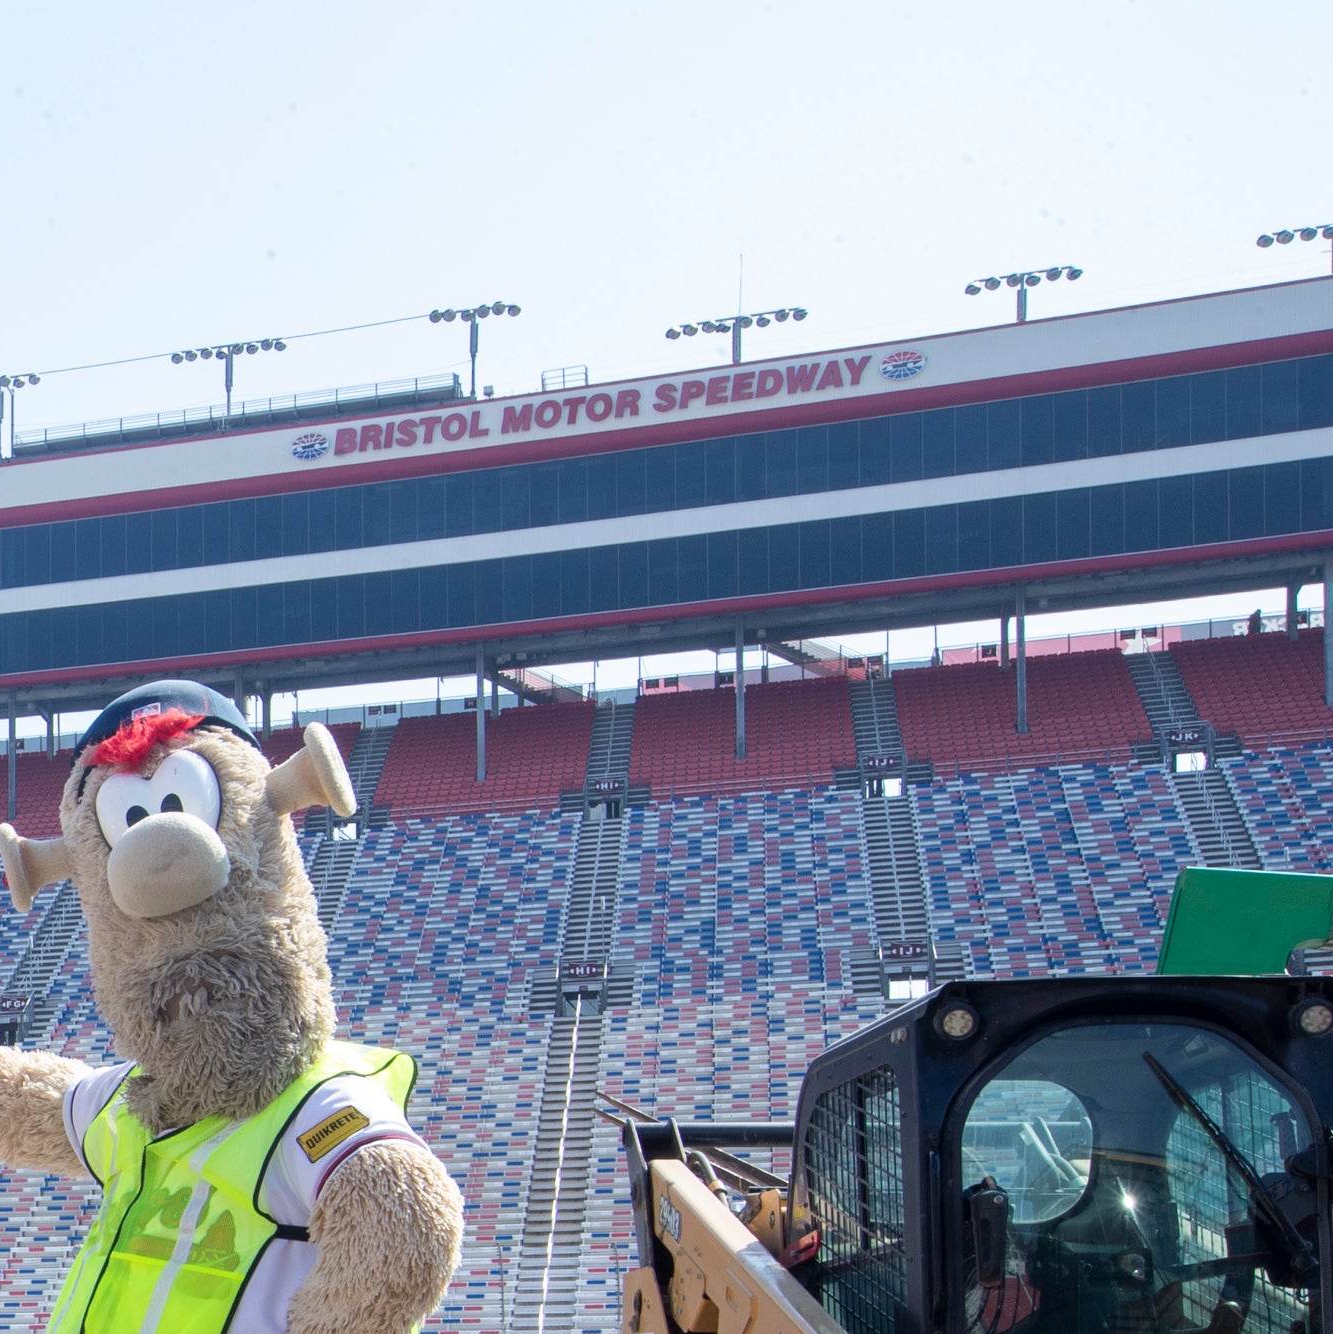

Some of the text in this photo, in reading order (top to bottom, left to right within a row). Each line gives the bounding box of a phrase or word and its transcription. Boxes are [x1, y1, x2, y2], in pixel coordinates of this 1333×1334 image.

[334, 355, 872, 456] BRISTOL MOTOR SPEEDWAY
[305, 1112, 357, 1150] QUIKRETE
